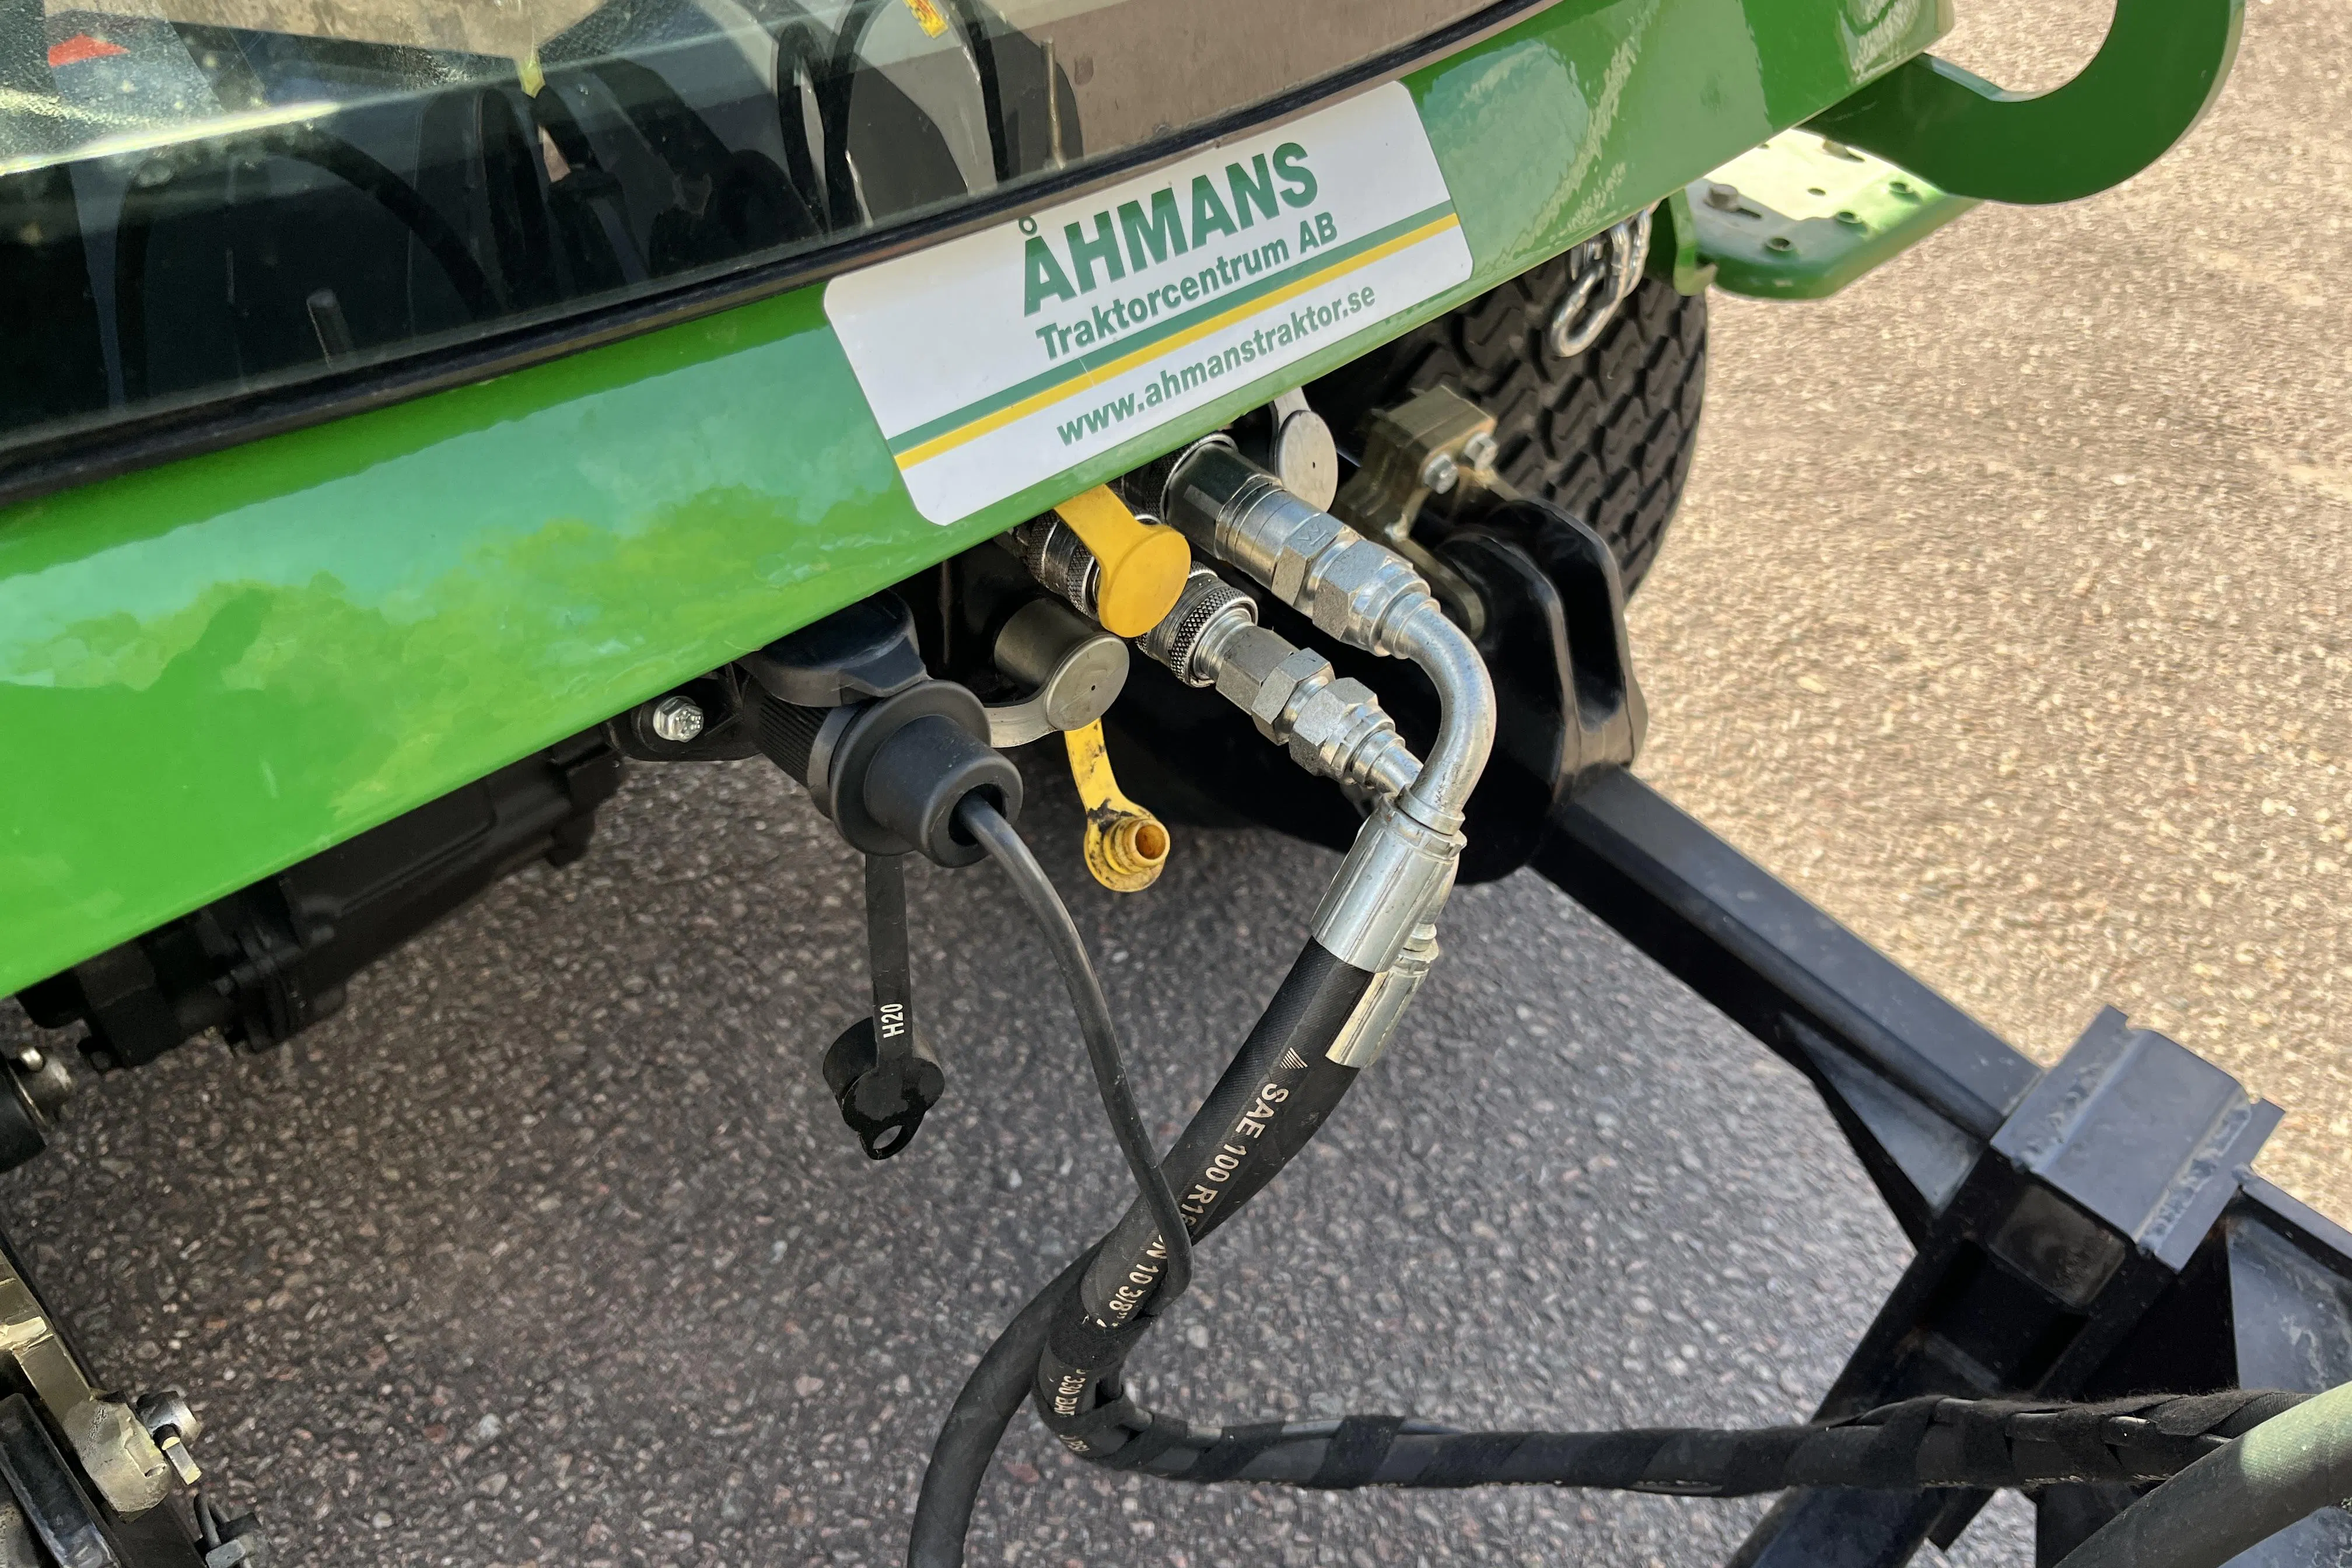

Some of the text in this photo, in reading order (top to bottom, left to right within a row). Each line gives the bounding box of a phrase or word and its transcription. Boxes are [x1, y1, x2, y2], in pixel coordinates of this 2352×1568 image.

[1019, 142, 1317, 317] ÅHMANS
[1036, 211, 1338, 360] Traktorcentrum AB
[1056, 286, 1375, 446] www.ahmanstraktor.se
[1236, 1083, 1289, 1138] SAE
[1205, 1144, 1247, 1182] 100
[1129, 1264, 1158, 1284] 10
[1058, 1376, 1086, 1394] 330
